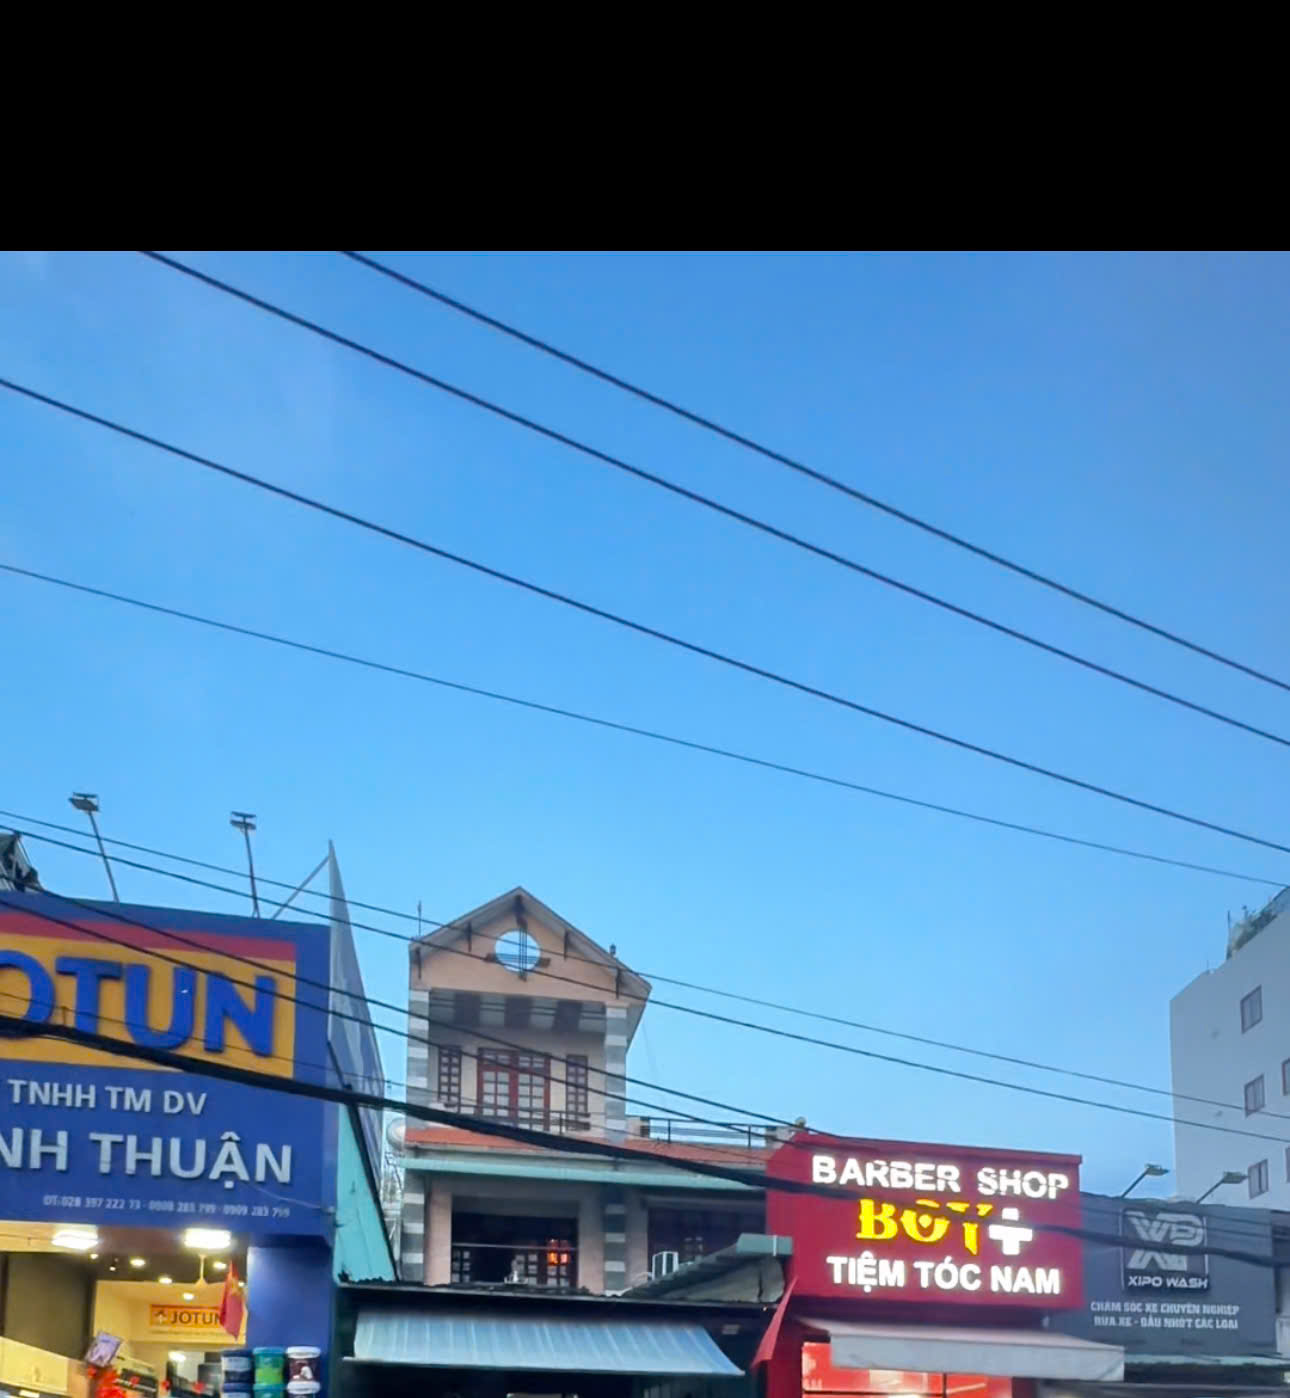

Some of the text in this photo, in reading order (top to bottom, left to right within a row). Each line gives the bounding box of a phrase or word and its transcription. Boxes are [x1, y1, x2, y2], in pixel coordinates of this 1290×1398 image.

[7, 1079, 207, 1115] TNHH TM DV
[89, 1131, 292, 1190] THUẬN
[812, 1154, 1069, 1200] BARBER SHOP
[826, 1250, 1061, 1295] TIỆM TÓC NAM
[1128, 1276, 1208, 1289] XIPO WASH
